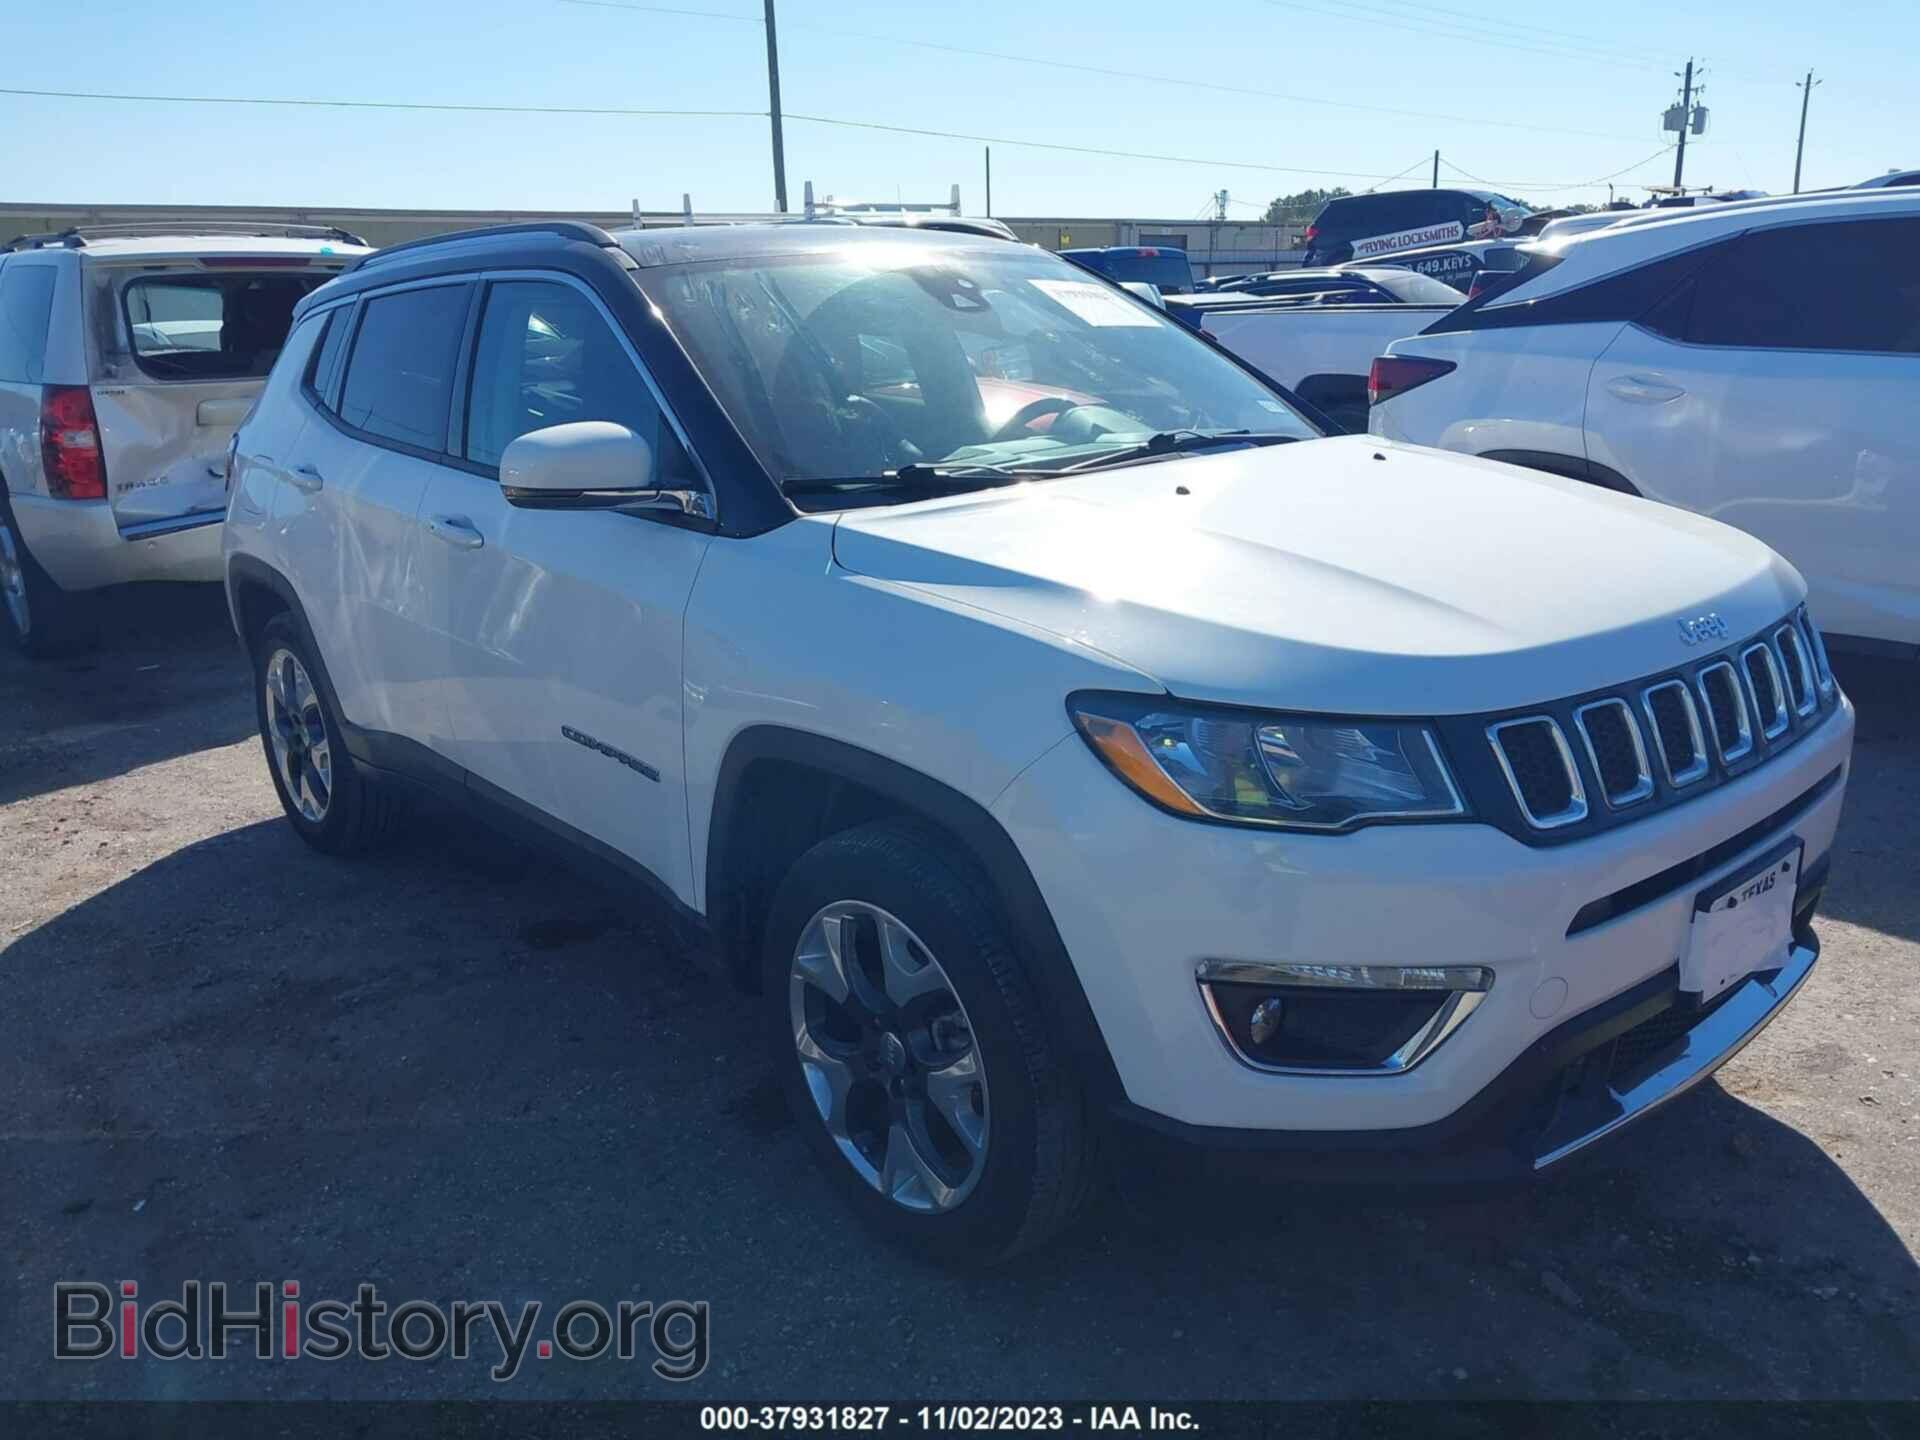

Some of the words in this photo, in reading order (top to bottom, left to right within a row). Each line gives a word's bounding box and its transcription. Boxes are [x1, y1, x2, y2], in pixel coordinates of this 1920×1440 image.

[1364, 237, 1397, 253] FLYING
[1398, 225, 1460, 247] LOCKSMITHS
[1742, 870, 1776, 902] TEXAS
